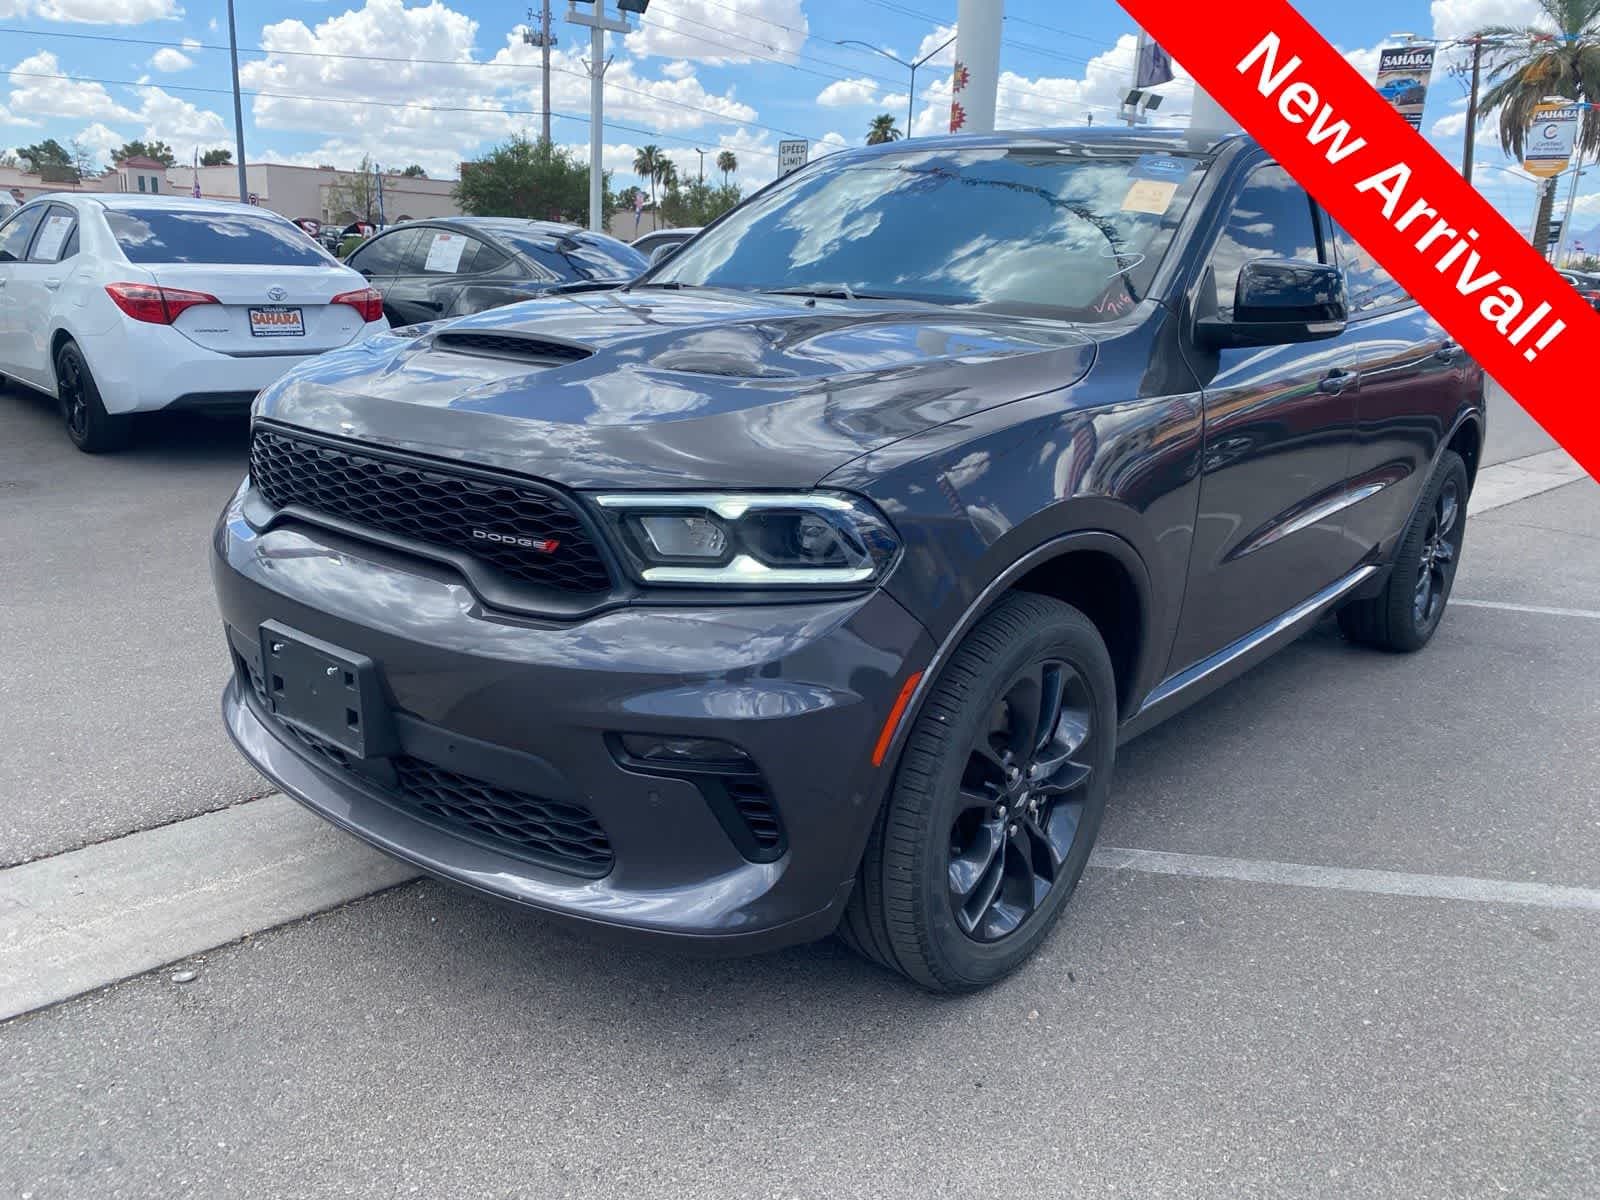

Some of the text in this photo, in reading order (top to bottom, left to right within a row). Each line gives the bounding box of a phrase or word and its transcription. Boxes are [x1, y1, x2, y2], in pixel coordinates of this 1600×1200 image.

[1383, 54, 1433, 67] SAHARA
[1536, 109, 1578, 119] SAHARA
[782, 145, 805, 153] SPEED
[783, 157, 802, 166] LIMIT
[252, 312, 301, 325] SAHARA
[472, 530, 547, 550] DODGE
